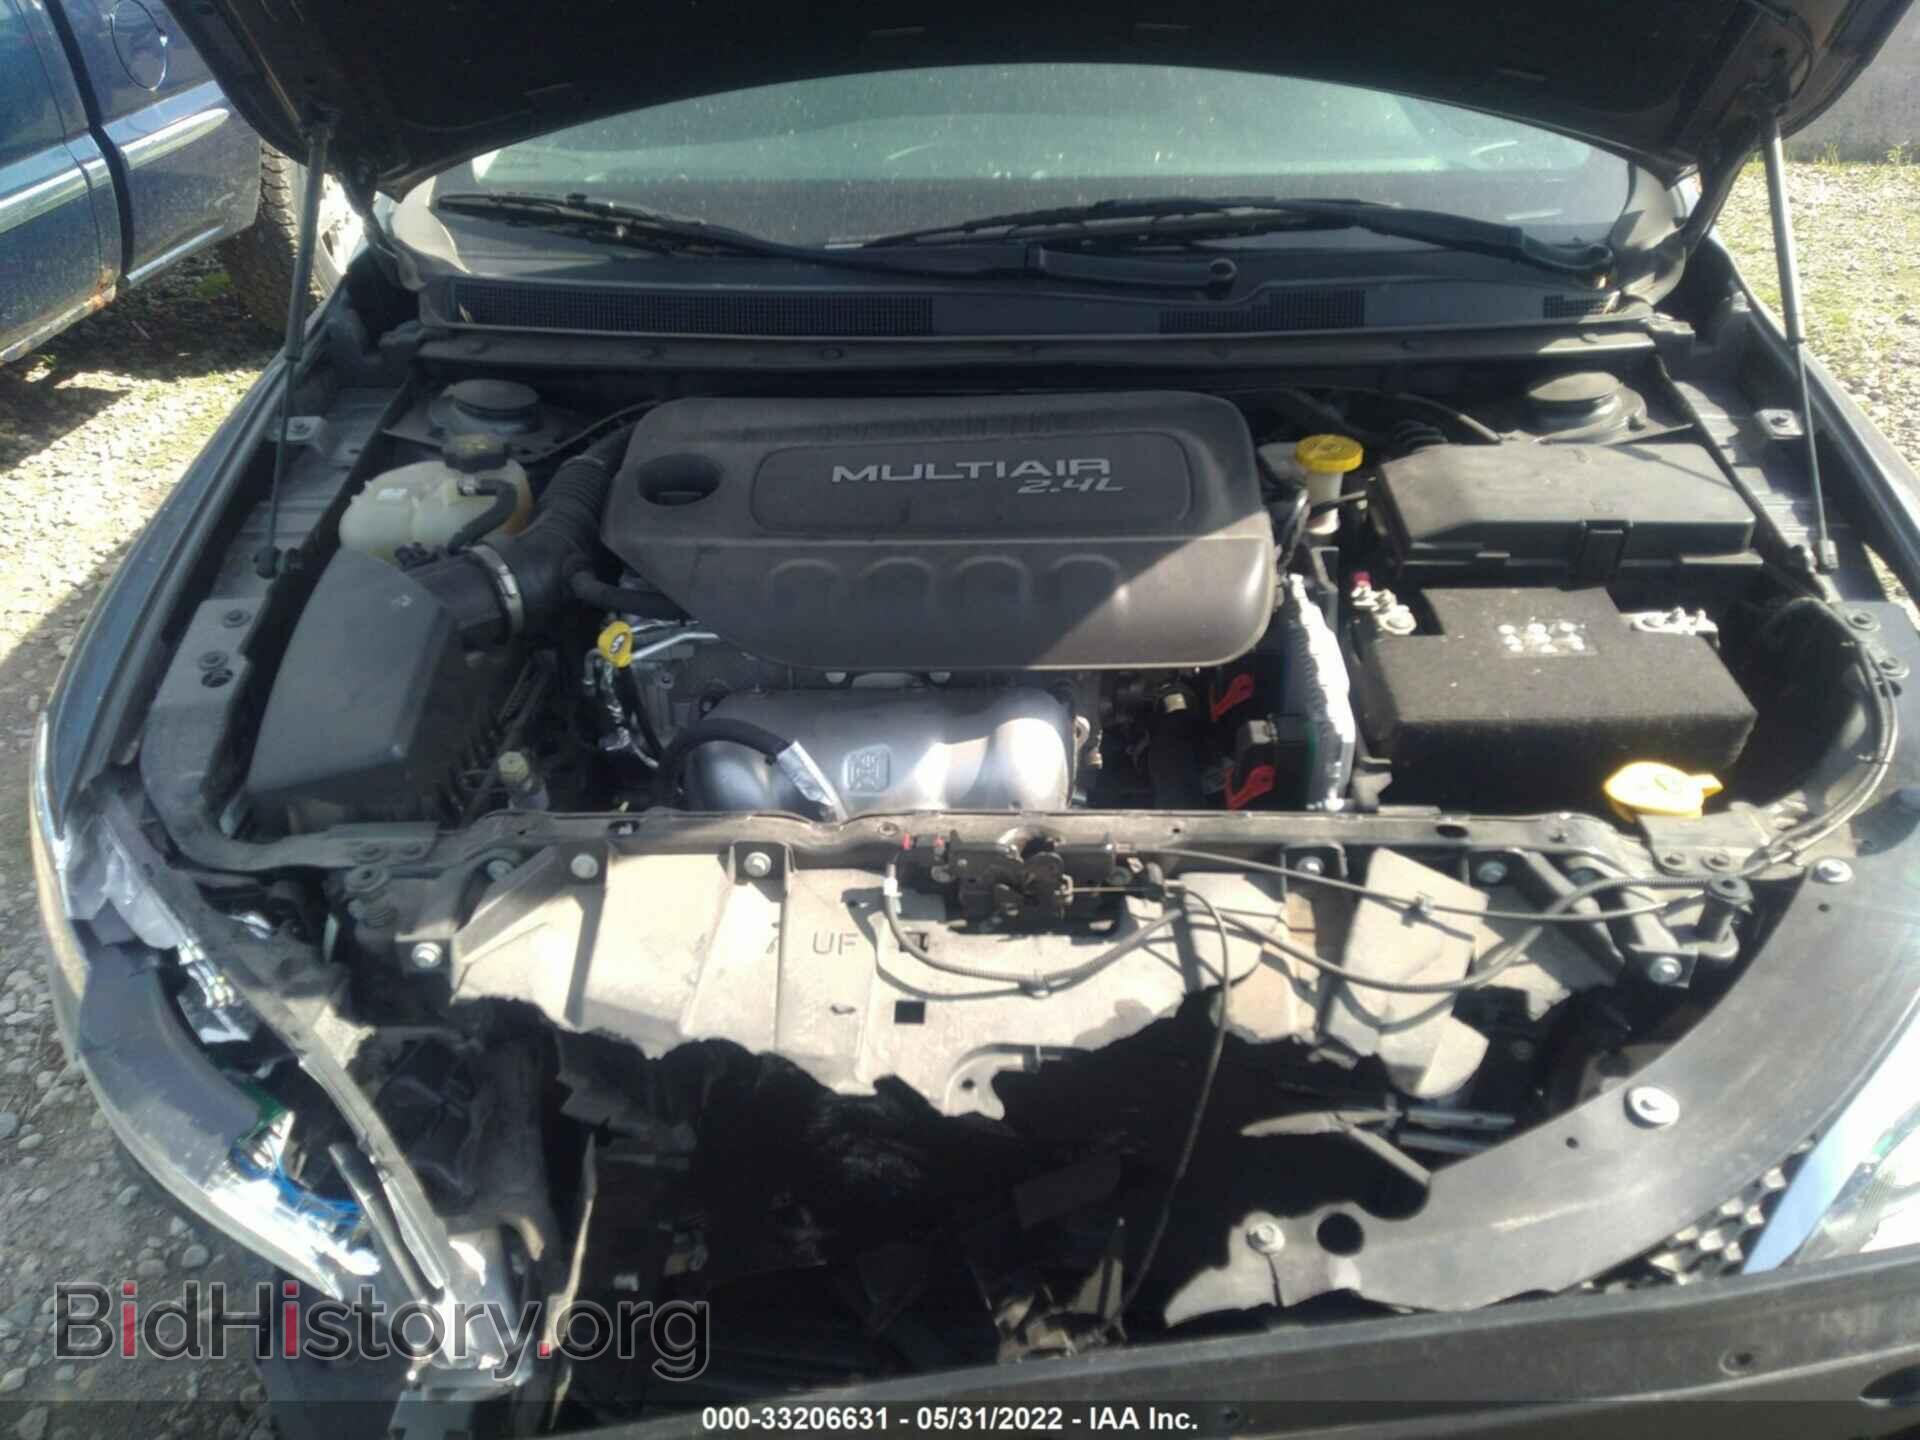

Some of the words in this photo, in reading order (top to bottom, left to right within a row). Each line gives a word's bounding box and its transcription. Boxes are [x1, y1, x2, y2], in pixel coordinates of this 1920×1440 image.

[832, 458, 1111, 483] MULTIAIR
[1017, 477, 1124, 494] 2.4L
[812, 931, 859, 955] UF
